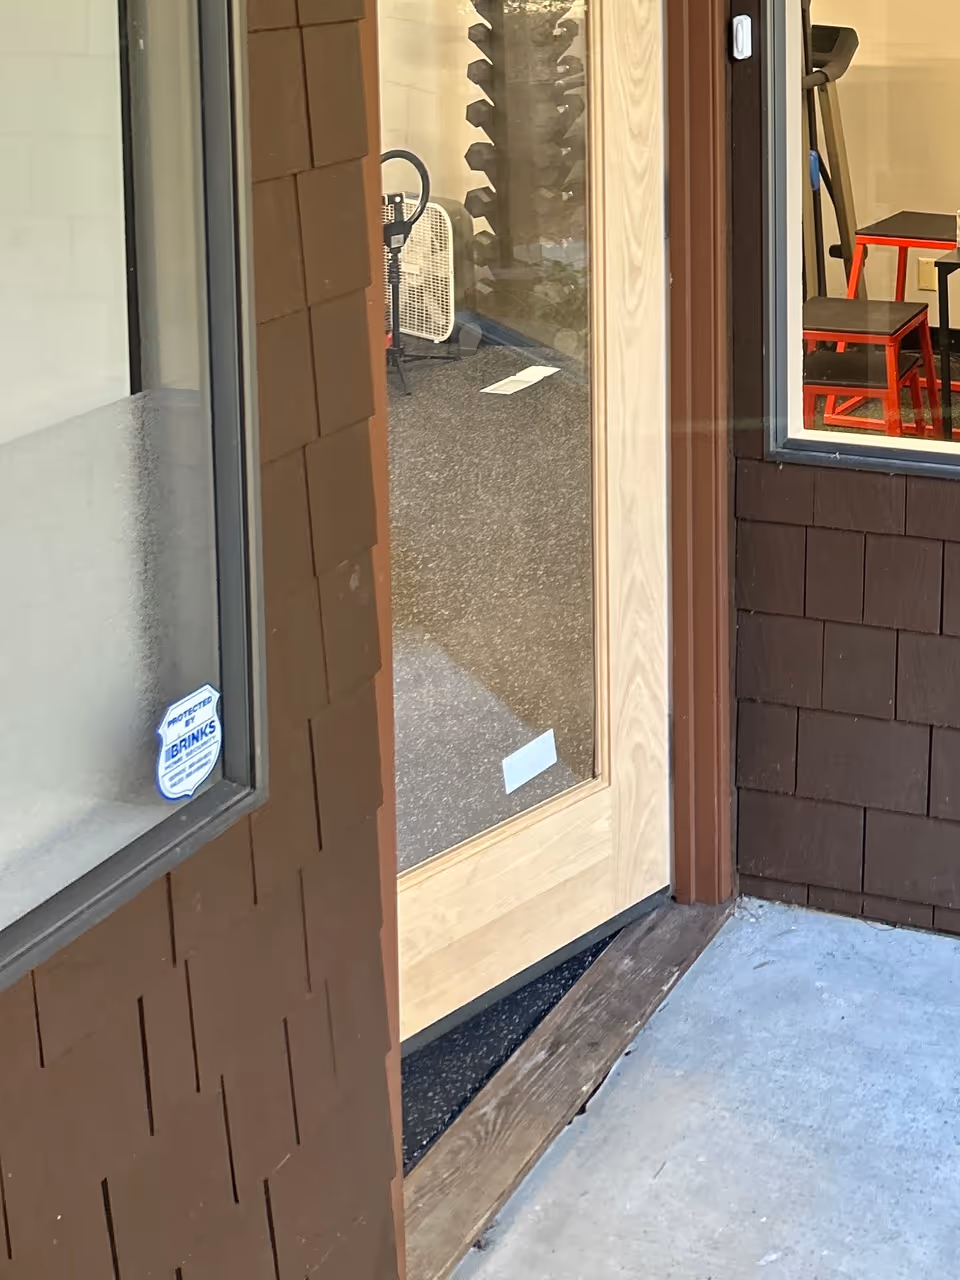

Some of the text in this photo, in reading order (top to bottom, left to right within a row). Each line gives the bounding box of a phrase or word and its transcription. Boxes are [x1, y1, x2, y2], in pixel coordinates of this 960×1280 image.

[167, 696, 213, 729] PROTECTED
[185, 715, 196, 728] BY
[171, 720, 216, 759] BRINKS
